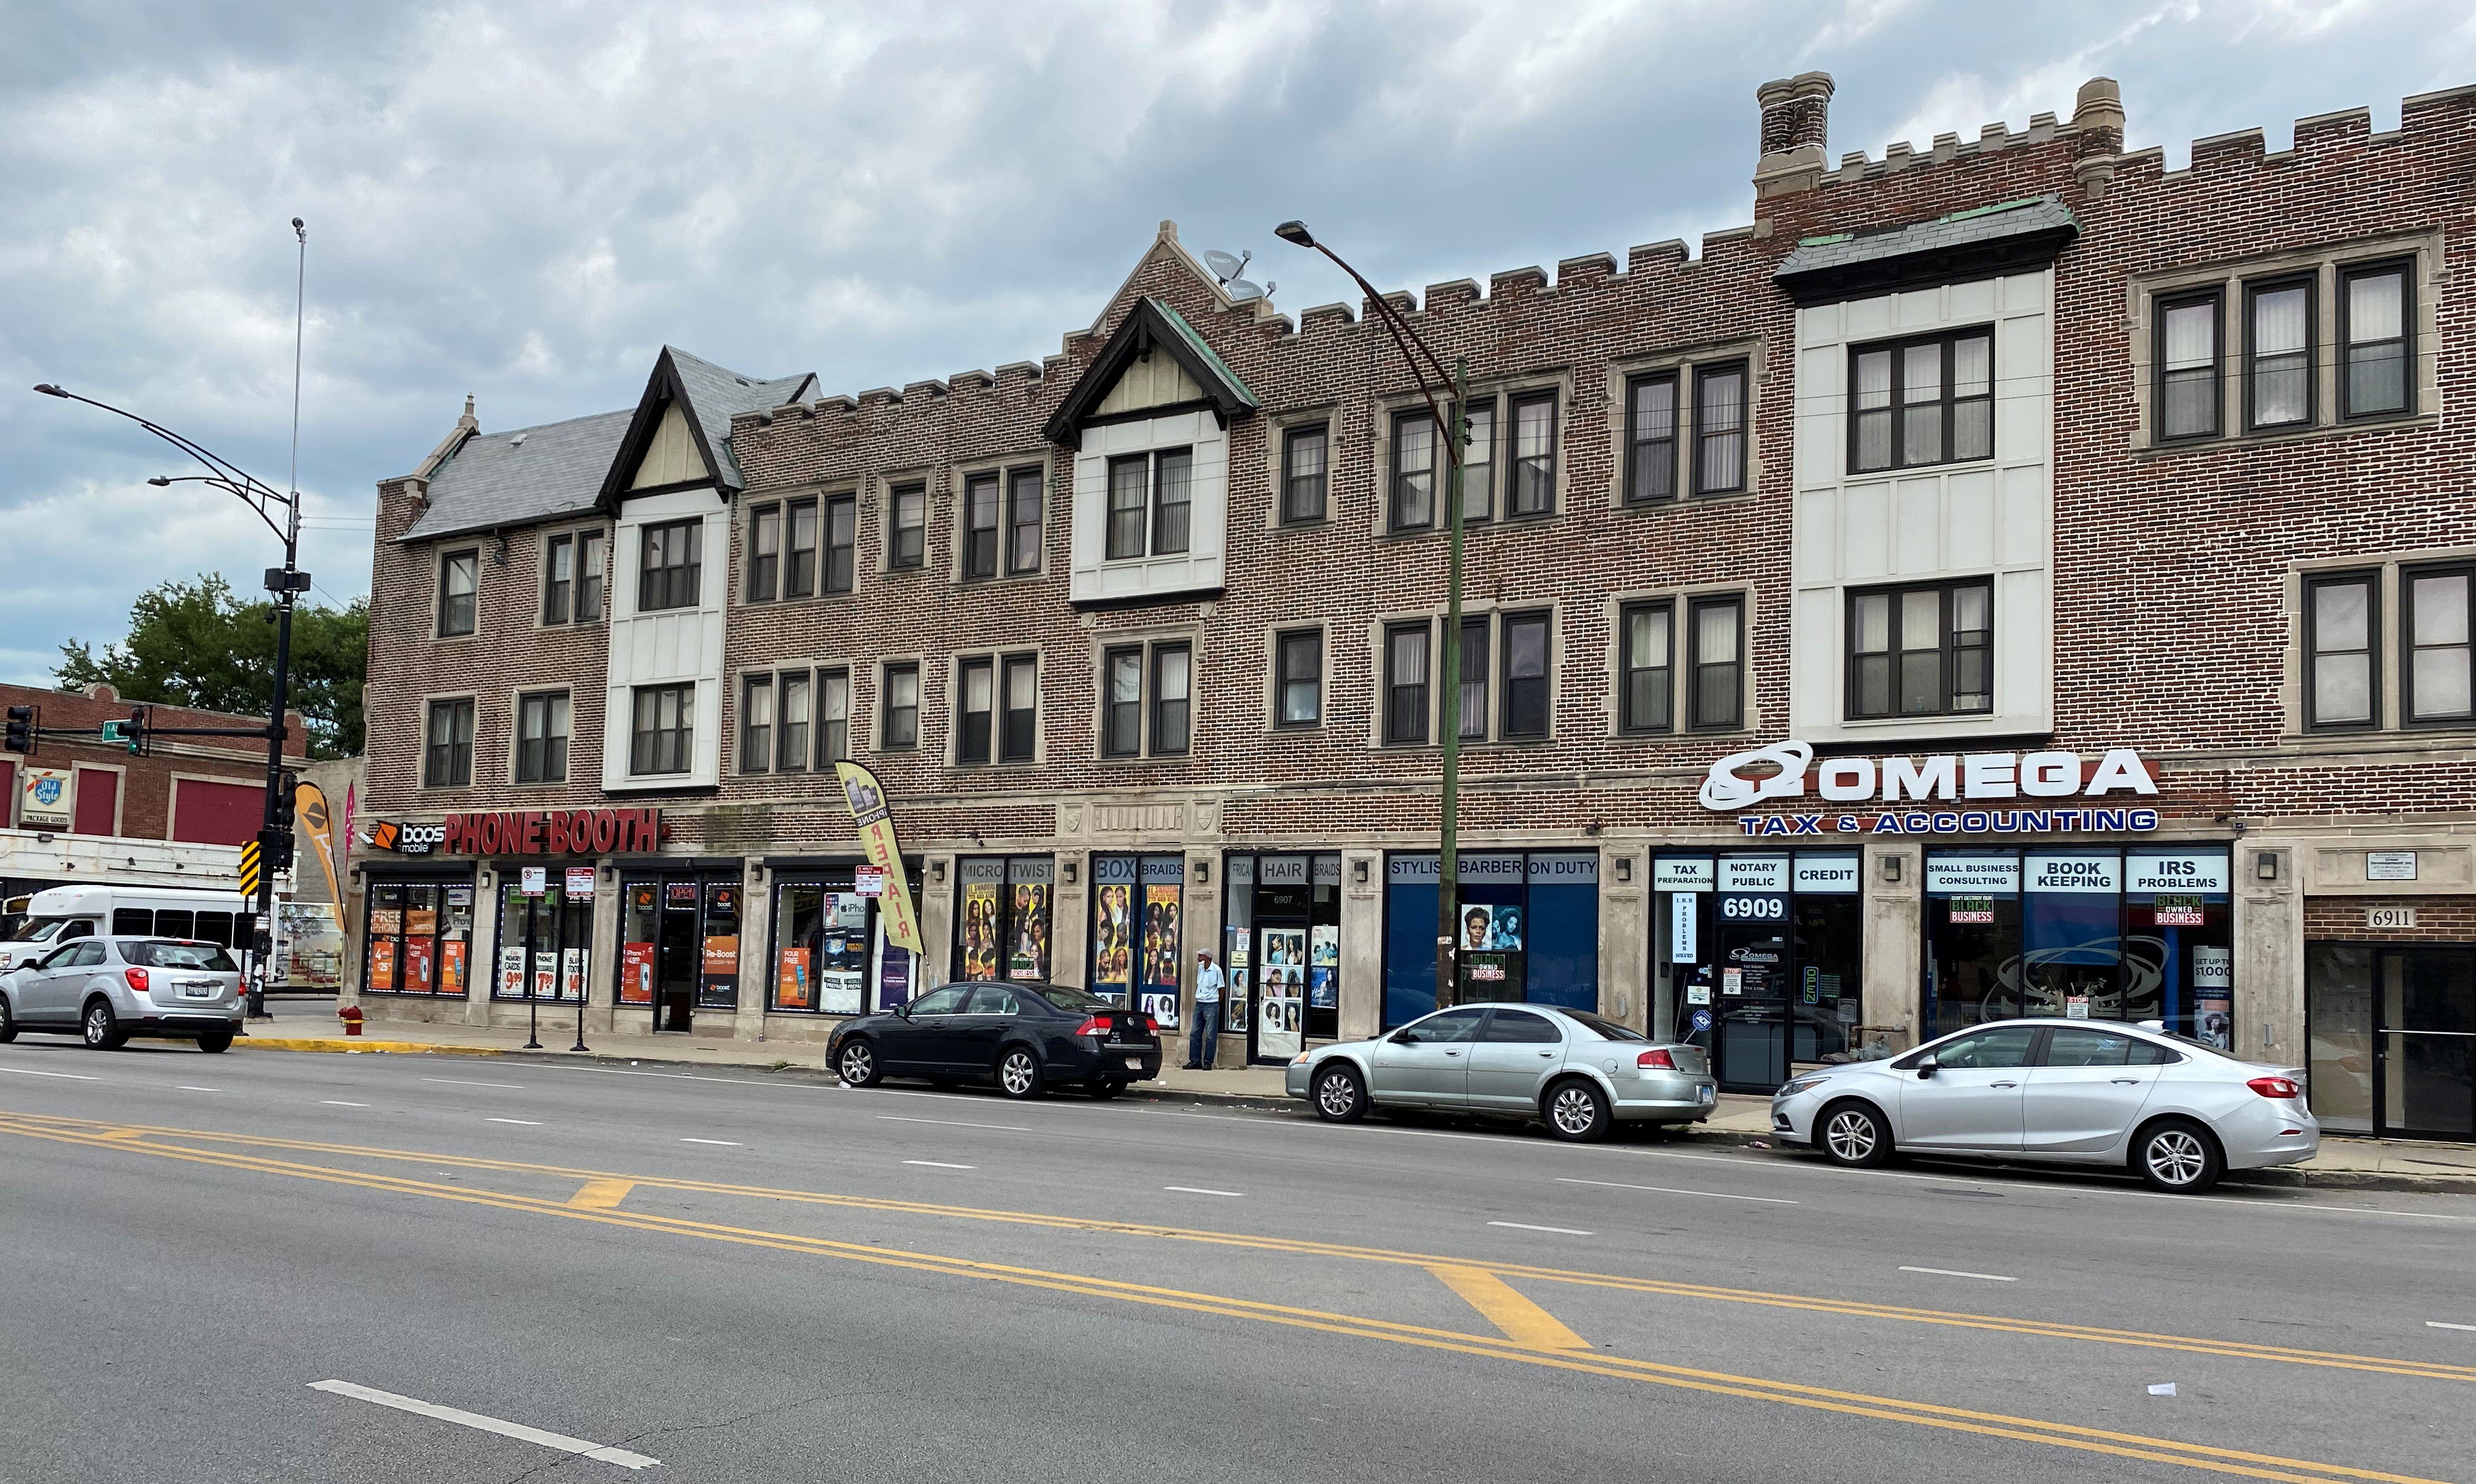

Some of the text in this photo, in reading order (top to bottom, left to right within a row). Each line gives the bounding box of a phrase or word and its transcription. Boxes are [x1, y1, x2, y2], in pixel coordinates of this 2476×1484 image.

[1818, 749, 2158, 801] OMEGA
[41, 780, 57, 790] Old
[37, 788, 59, 803] Style
[1738, 809, 2158, 836] TAX & ACCOUNTING
[402, 823, 446, 843] boos
[444, 809, 658, 854] PHONE BOOTH
[402, 843, 428, 852] mobile
[964, 864, 1054, 877] MICRO TWIST
[1098, 860, 1183, 878] BOX BRAIDS
[1228, 864, 1340, 877] FRICAN HAIR BRAIDS
[1391, 860, 1597, 875] STYLIS BARBER ON DUTY
[1673, 865, 1697, 875] TAX
[1730, 864, 1777, 872] NOTARY
[2047, 862, 2101, 875] BOOK
[2159, 861, 2196, 875] IRS
[1799, 870, 1853, 880] CREDIT
[1732, 878, 1774, 886] PUBLIC
[2037, 876, 2111, 887] KEEPING
[2138, 878, 2217, 888] PROBLEMS
[672, 887, 695, 898] OPEN
[1952, 901, 1991, 911] BLACK
[2157, 895, 2201, 906] BLACK
[848, 904, 865, 912] iPho
[1723, 898, 1783, 918] 6909
[373, 910, 400, 923] FREE
[1952, 911, 1992, 921] BUSINESS
[2156, 913, 2201, 923] BUSINESS
[2373, 910, 2409, 926] 6911
[706, 949, 736, 958] Re-Boost
[1012, 961, 1034, 969] BLACK
[1473, 955, 1503, 964] BLACK
[505, 962, 521, 970] CARDS
[1473, 970, 1504, 979] BUSINESS
[1807, 969, 1816, 1002] OPEN
[1696, 1015, 1710, 1027] ADT
